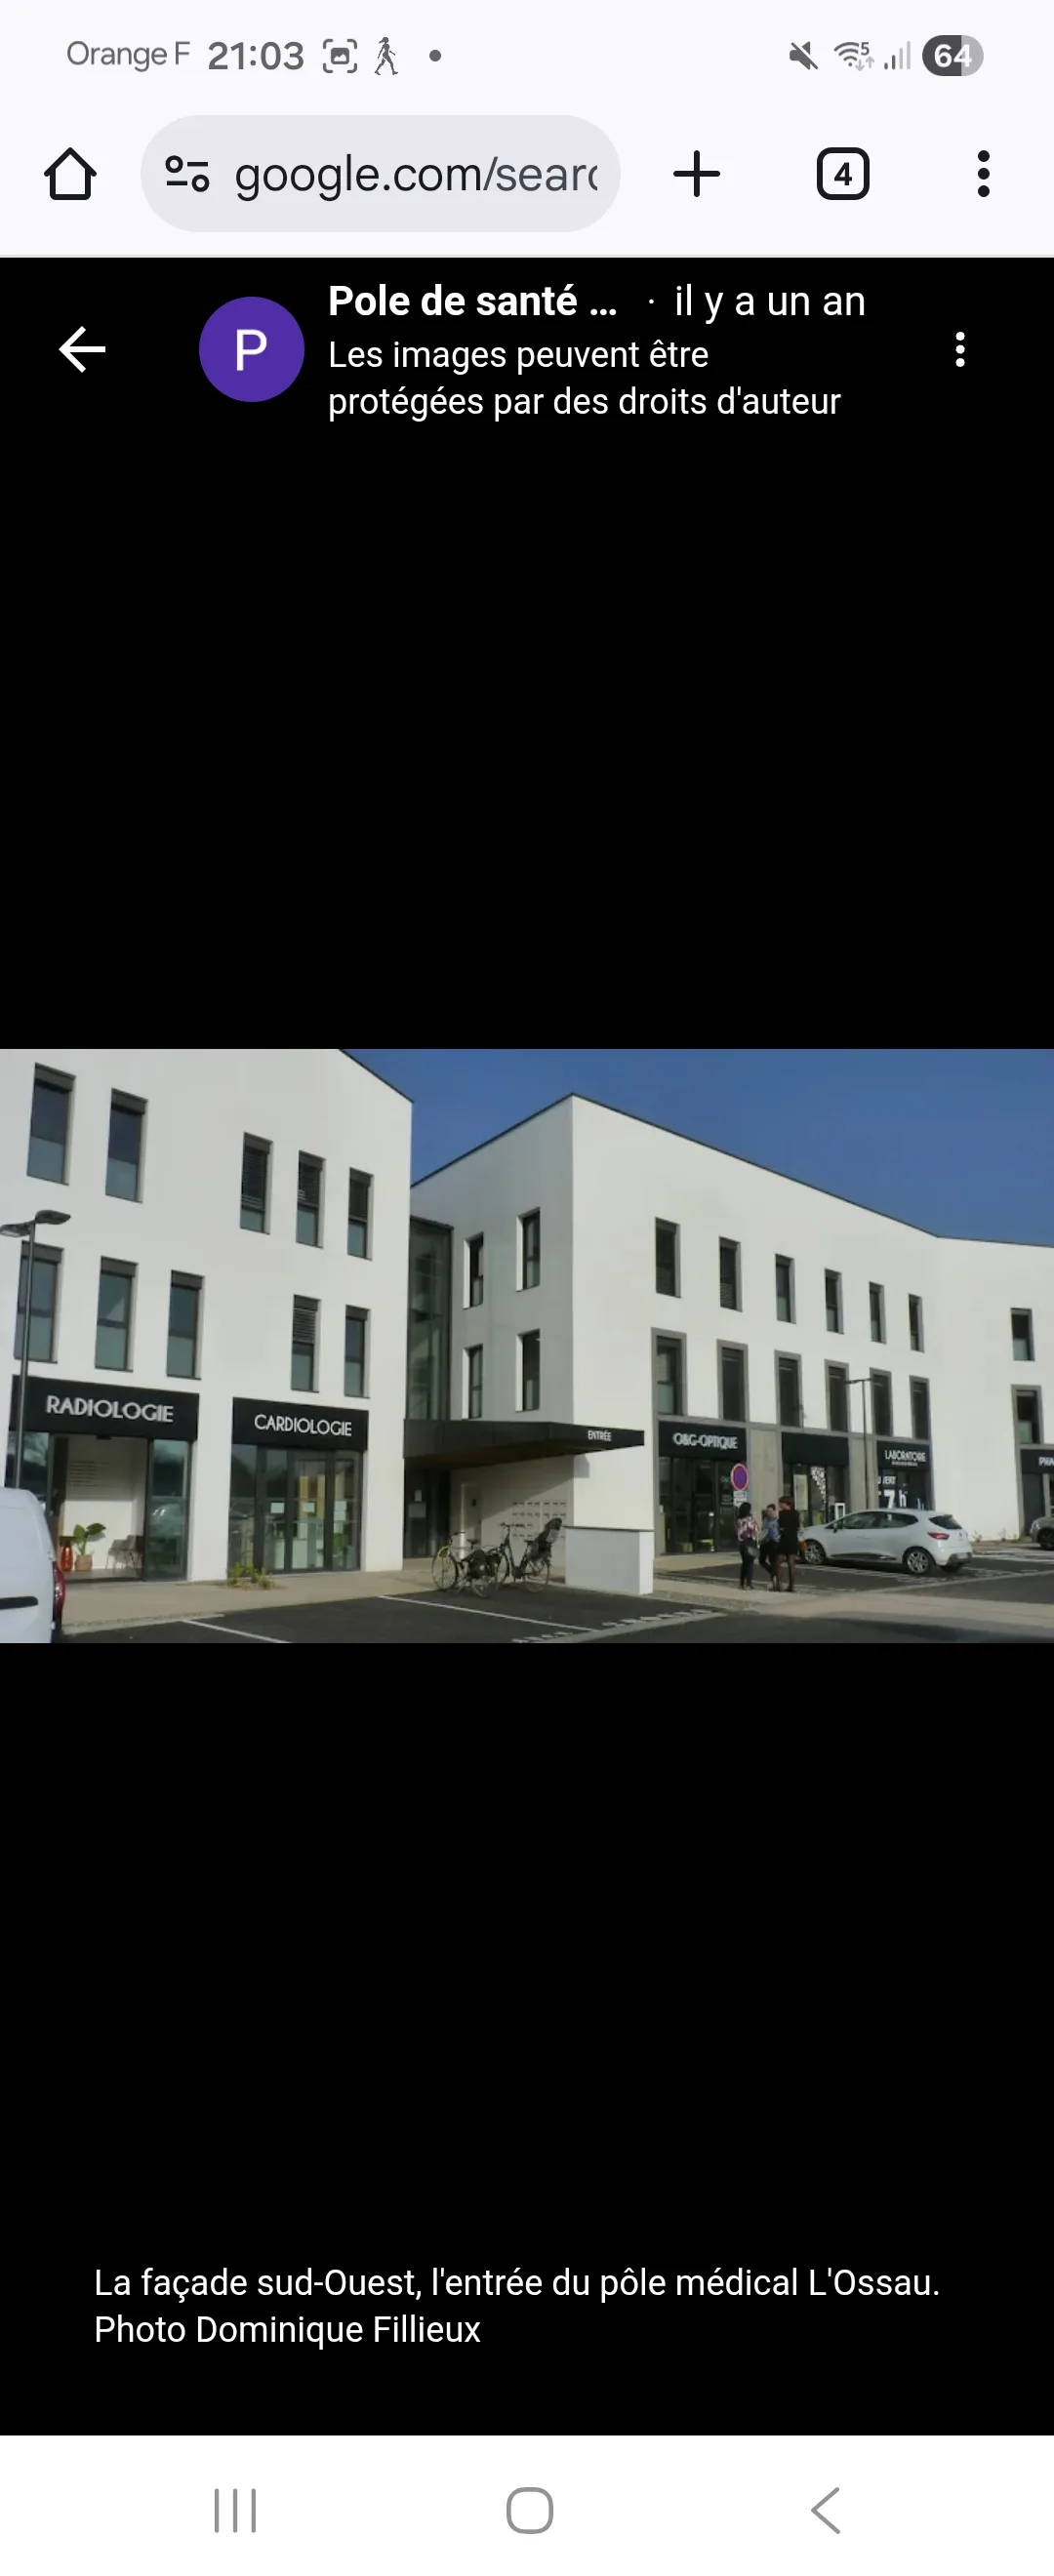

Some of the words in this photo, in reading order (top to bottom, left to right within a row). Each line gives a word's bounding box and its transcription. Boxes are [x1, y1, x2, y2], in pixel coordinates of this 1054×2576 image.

[47, 1395, 174, 1423] RADIOLOGIE
[254, 1414, 352, 1436] CARDIOLOGIE
[588, 1429, 613, 1442] ENTRÉE
[884, 1449, 926, 1463] LABORATOIRE
